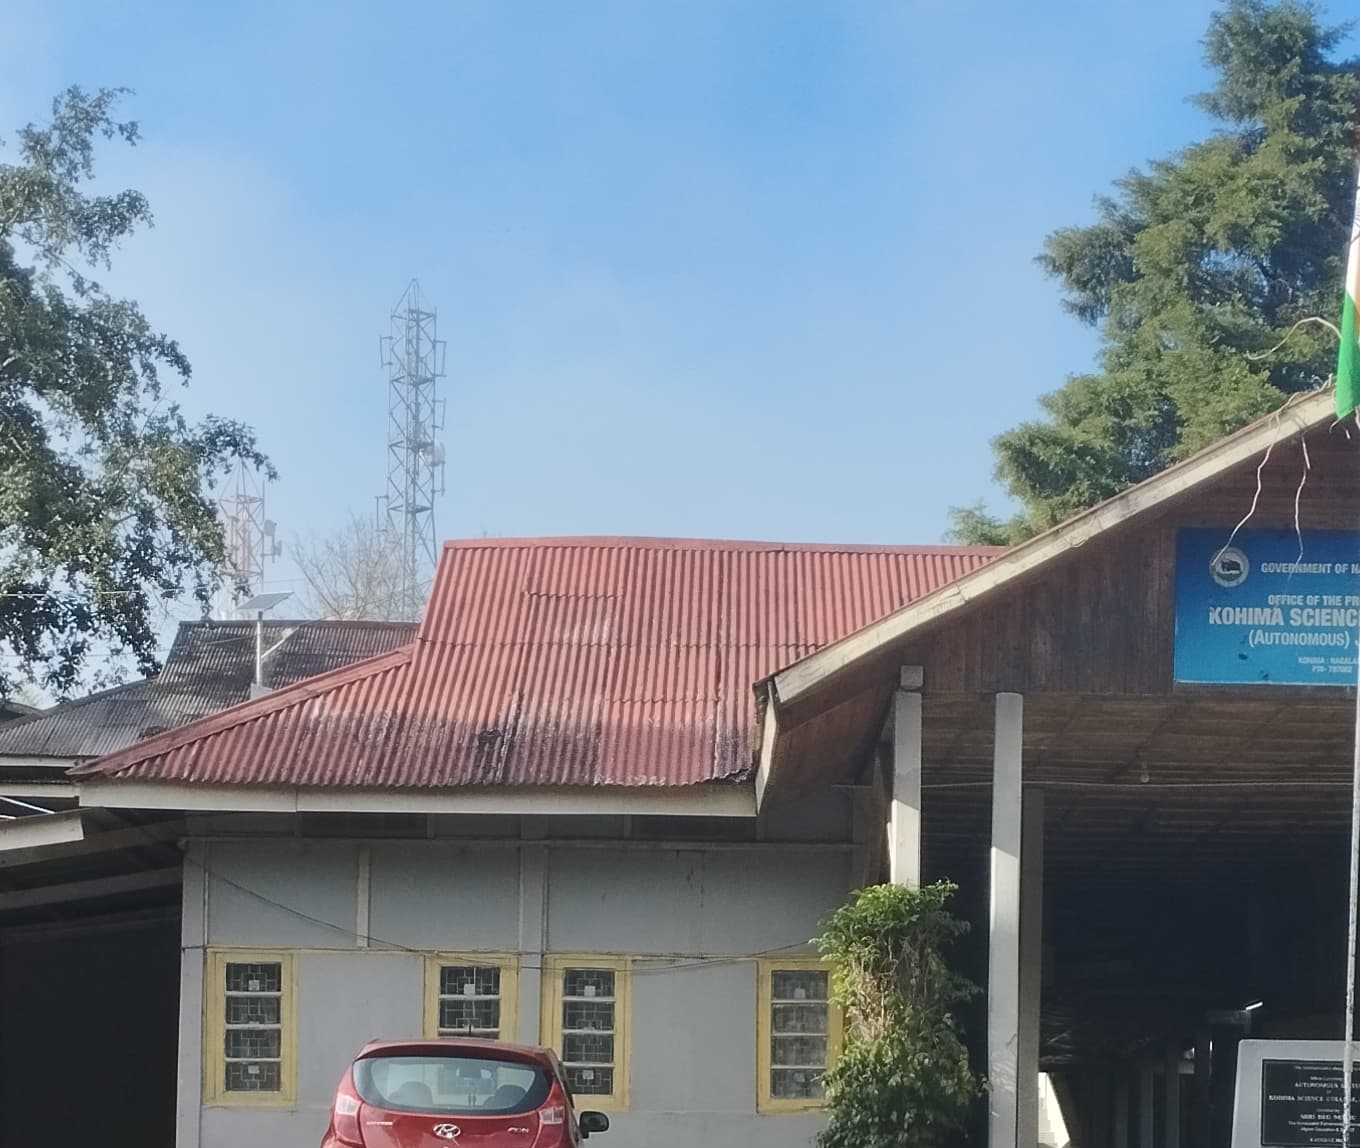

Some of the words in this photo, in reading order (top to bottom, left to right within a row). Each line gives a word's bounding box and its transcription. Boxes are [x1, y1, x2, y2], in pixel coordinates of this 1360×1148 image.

[1261, 562, 1331, 574] GOVERNMENT
[1335, 563, 1348, 574] OF
[1268, 595, 1304, 606] OFFICE
[1307, 595, 1320, 606] OF
[1322, 595, 1343, 606] THE
[1209, 607, 1284, 626] KOHIMA
